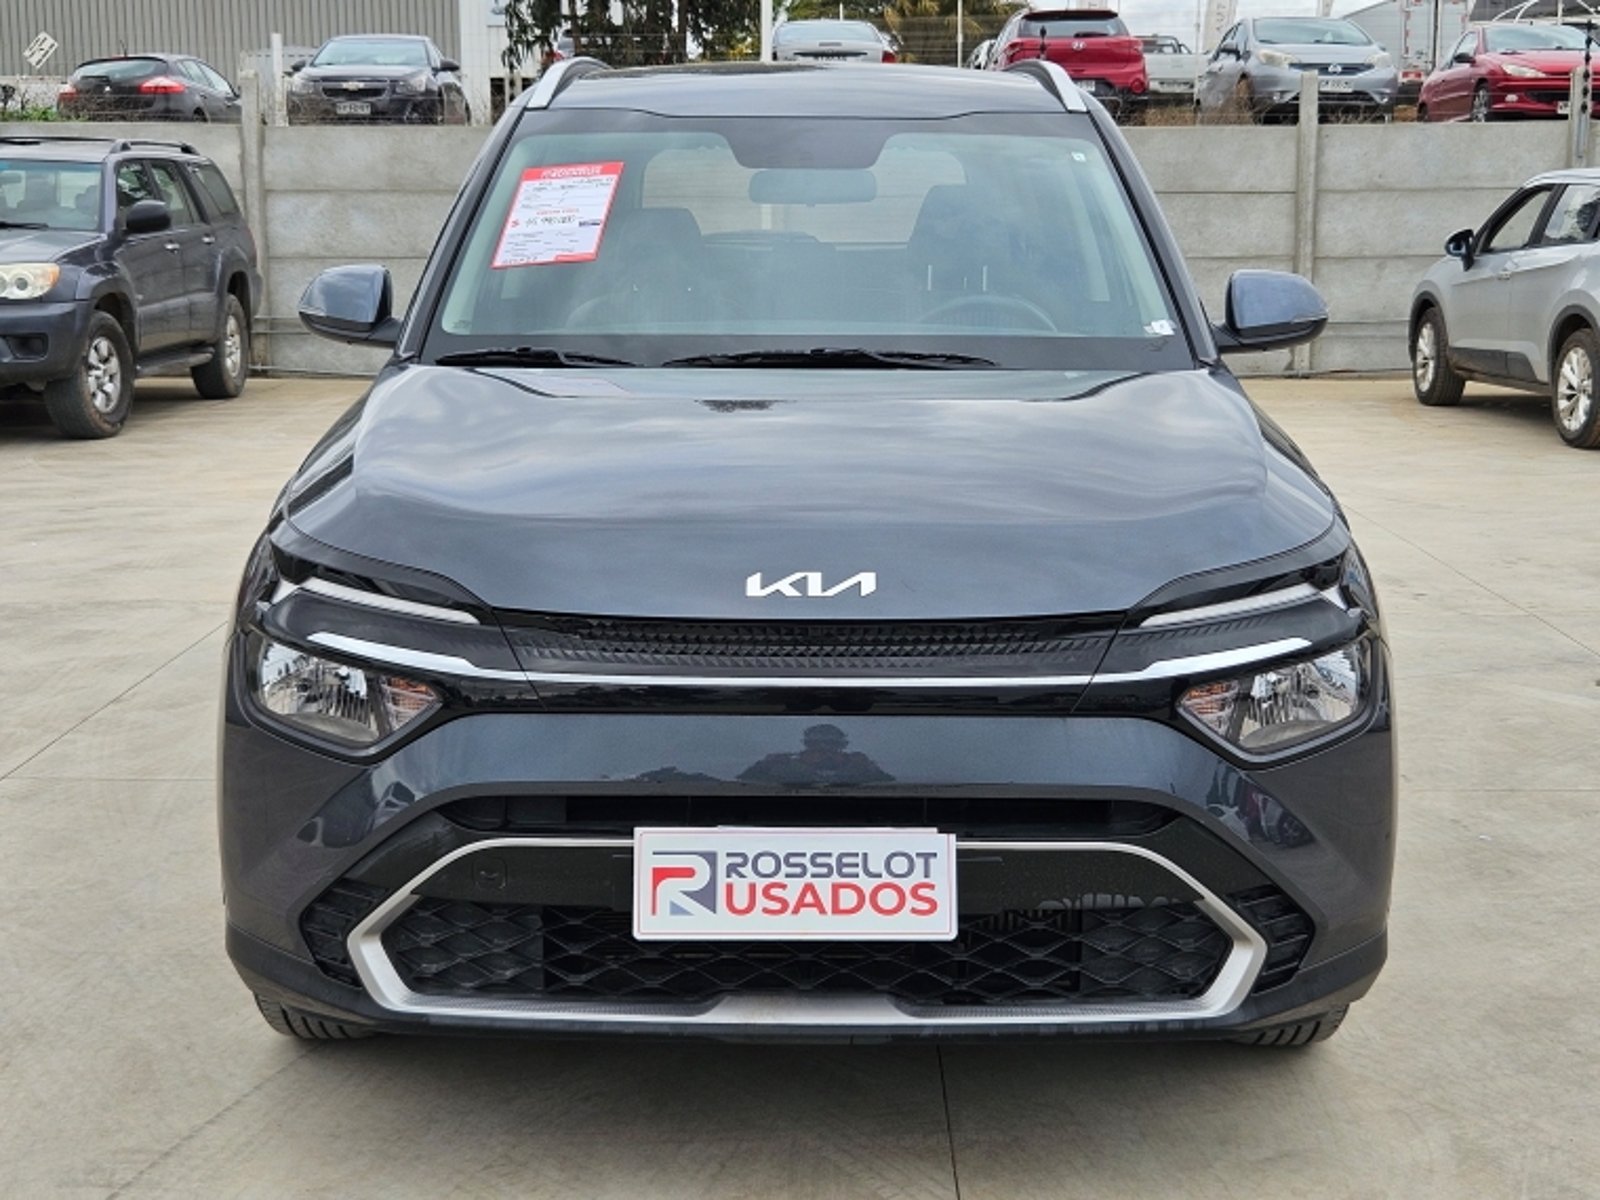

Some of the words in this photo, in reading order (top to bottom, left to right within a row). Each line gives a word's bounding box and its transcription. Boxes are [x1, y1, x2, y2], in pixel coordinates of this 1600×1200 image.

[745, 571, 877, 597] KIA
[725, 850, 938, 879] ROSSELOT
[725, 882, 939, 917] USADOS
